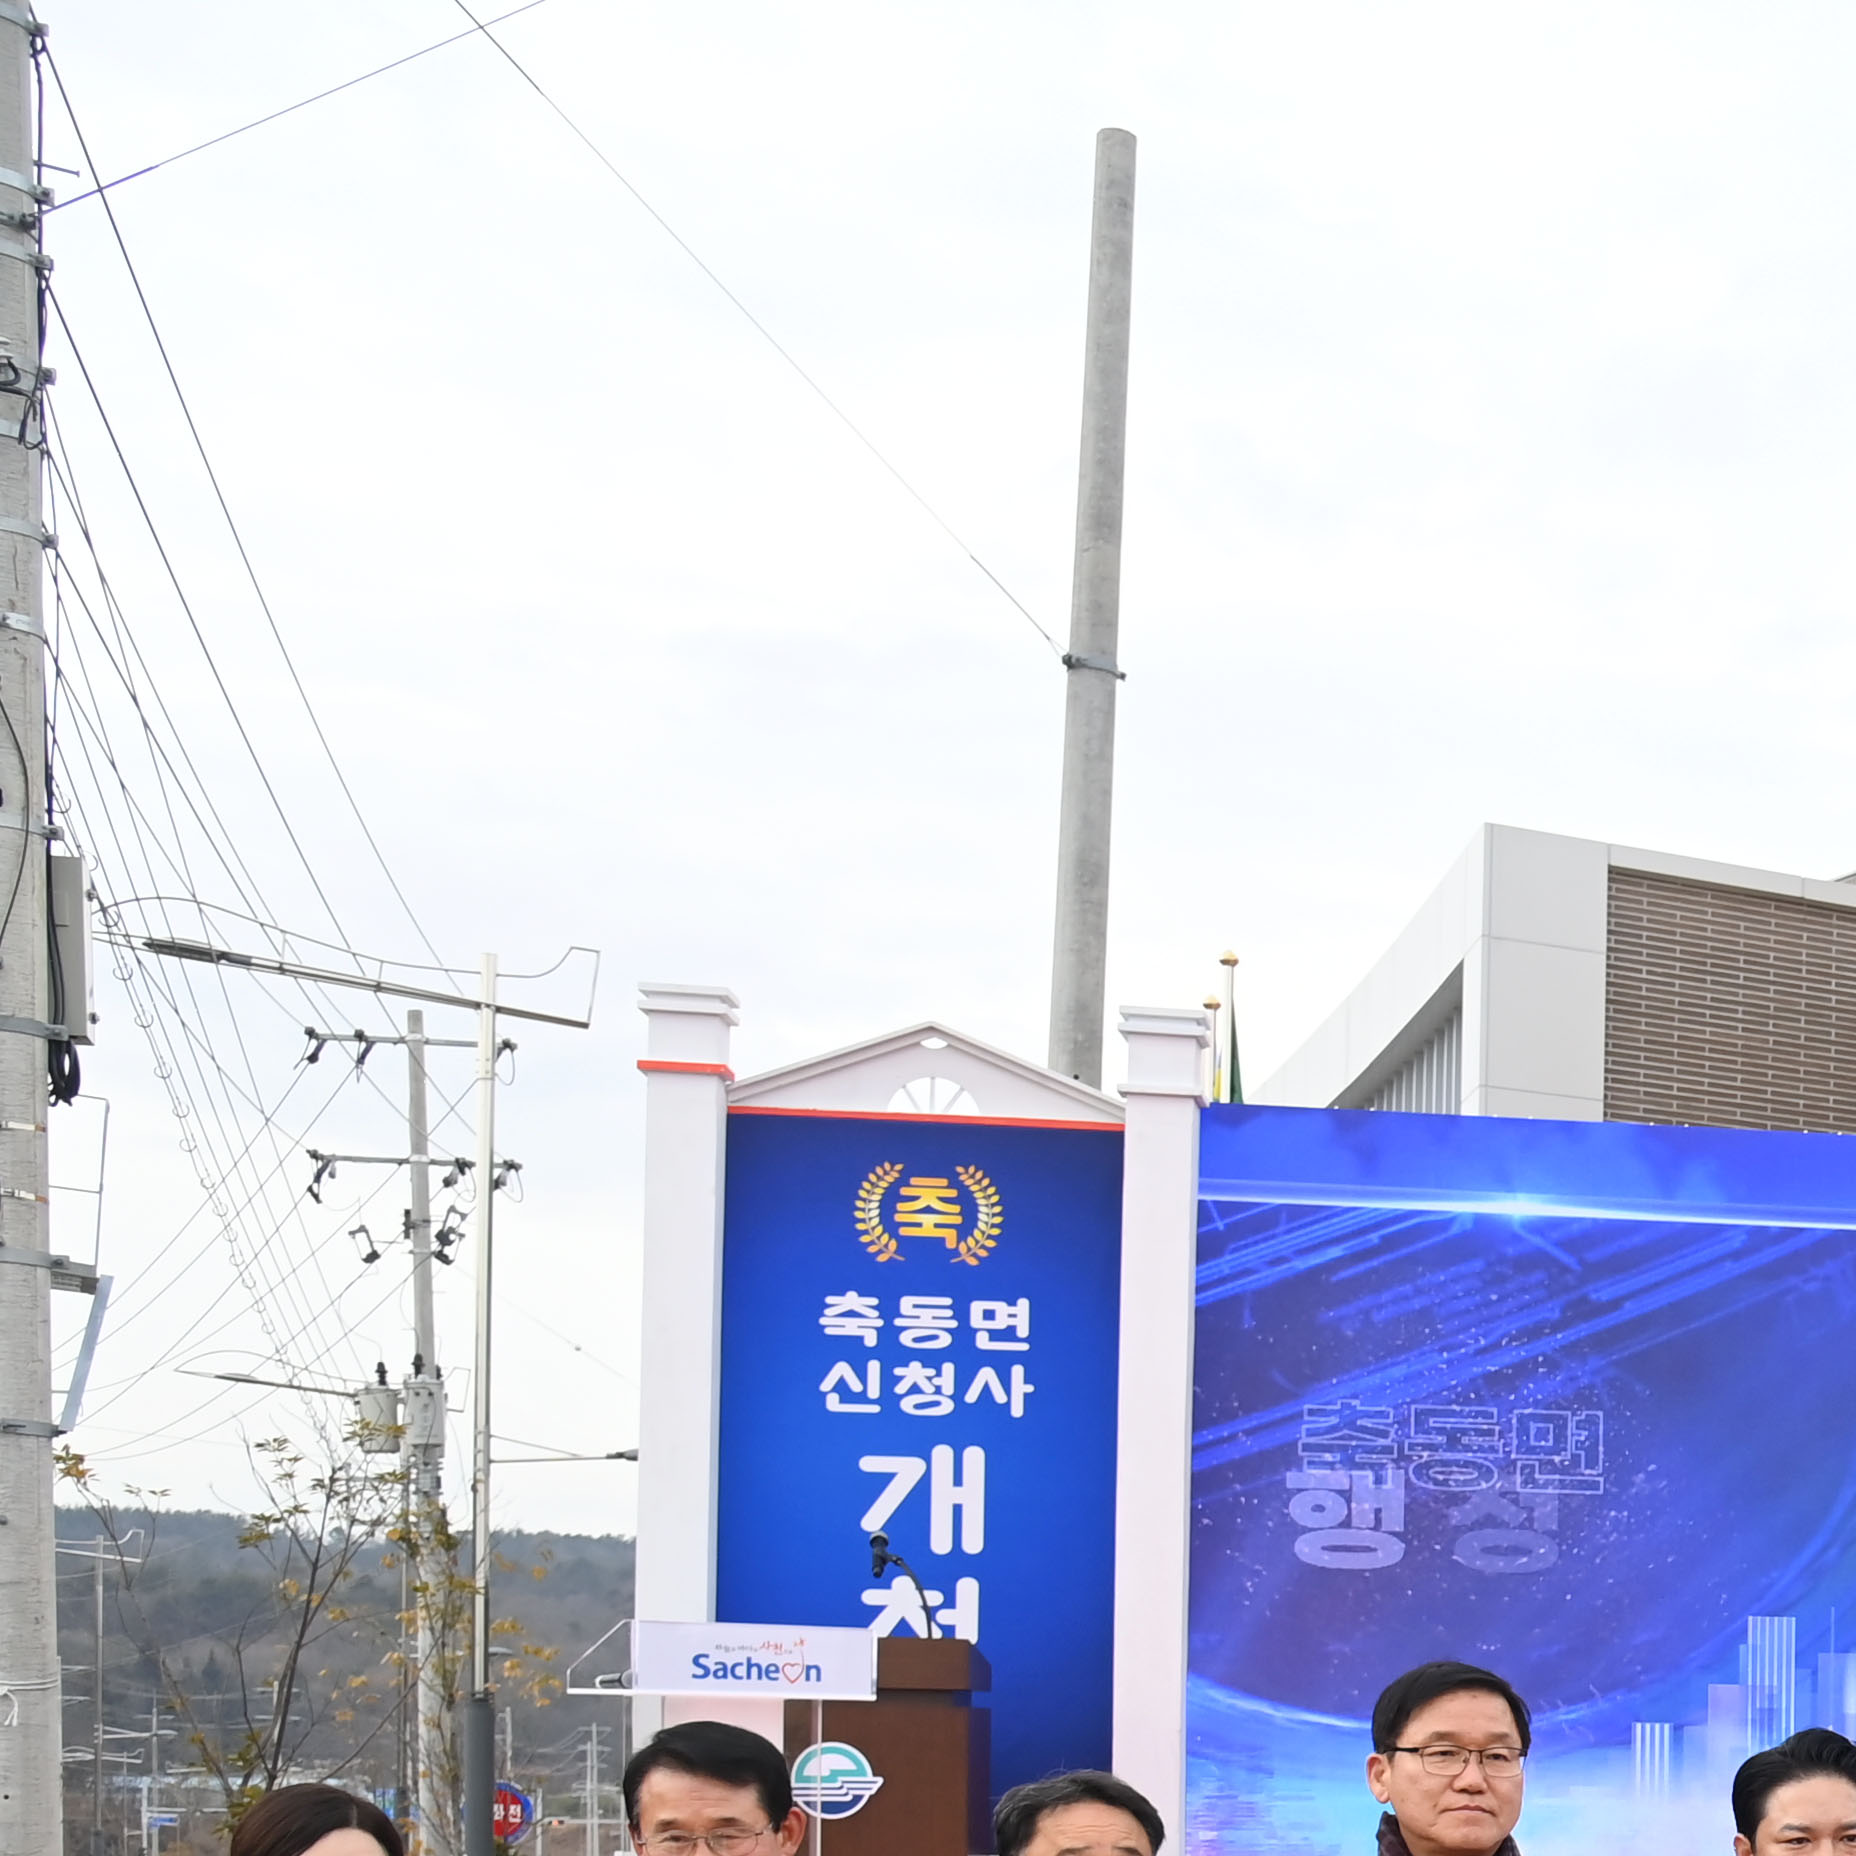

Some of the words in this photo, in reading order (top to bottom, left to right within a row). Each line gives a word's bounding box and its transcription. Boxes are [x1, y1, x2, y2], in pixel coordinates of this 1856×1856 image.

[893, 1174, 964, 1250] 축
[818, 1290, 1032, 1351] 축동면
[818, 1358, 1035, 1418] 신청사
[1297, 1398, 1605, 1495] 축동면
